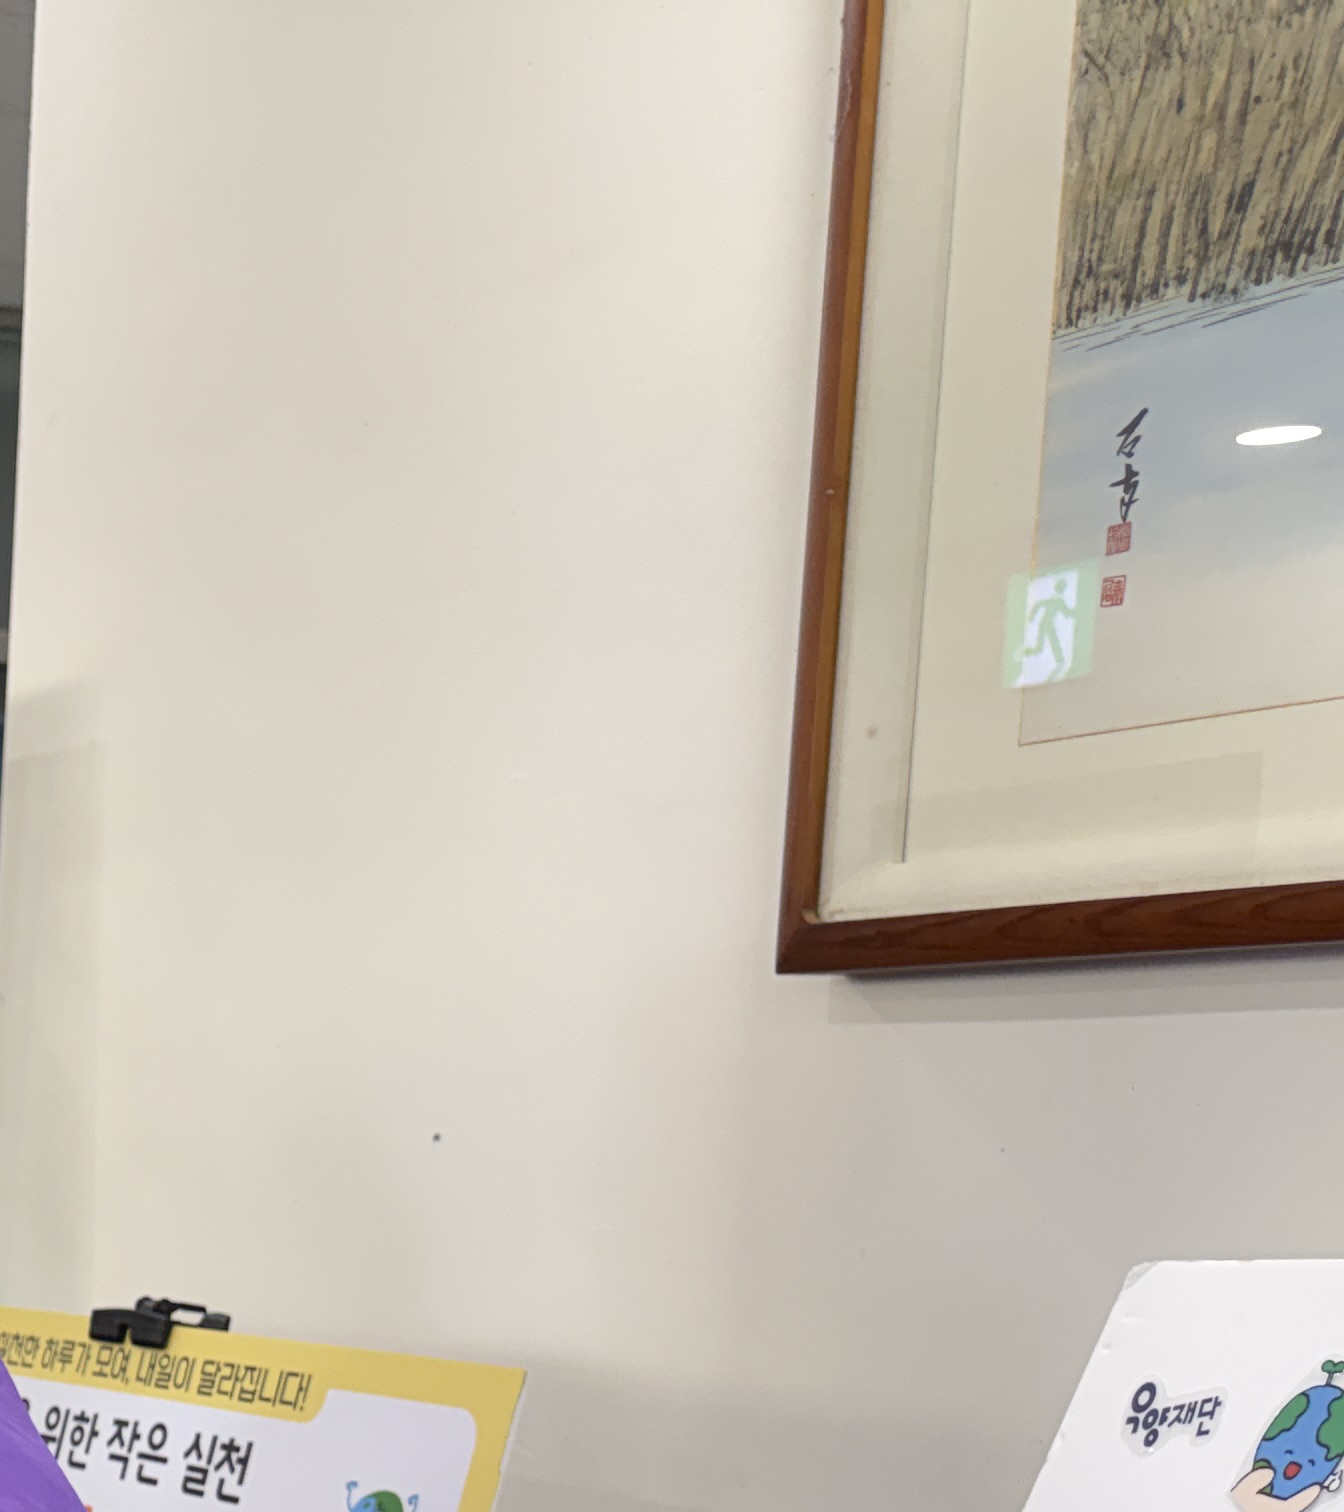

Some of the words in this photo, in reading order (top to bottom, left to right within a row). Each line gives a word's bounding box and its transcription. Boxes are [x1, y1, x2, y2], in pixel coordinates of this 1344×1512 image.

[41, 1337, 92, 1374] 하루가
[92, 1343, 131, 1385] 모여,
[135, 1350, 195, 1392] 내일이
[196, 1358, 312, 1412] 달라집니다!
[41, 1407, 99, 1470] 위한
[107, 1418, 168, 1486] 작은
[181, 1432, 254, 1504] 실천
